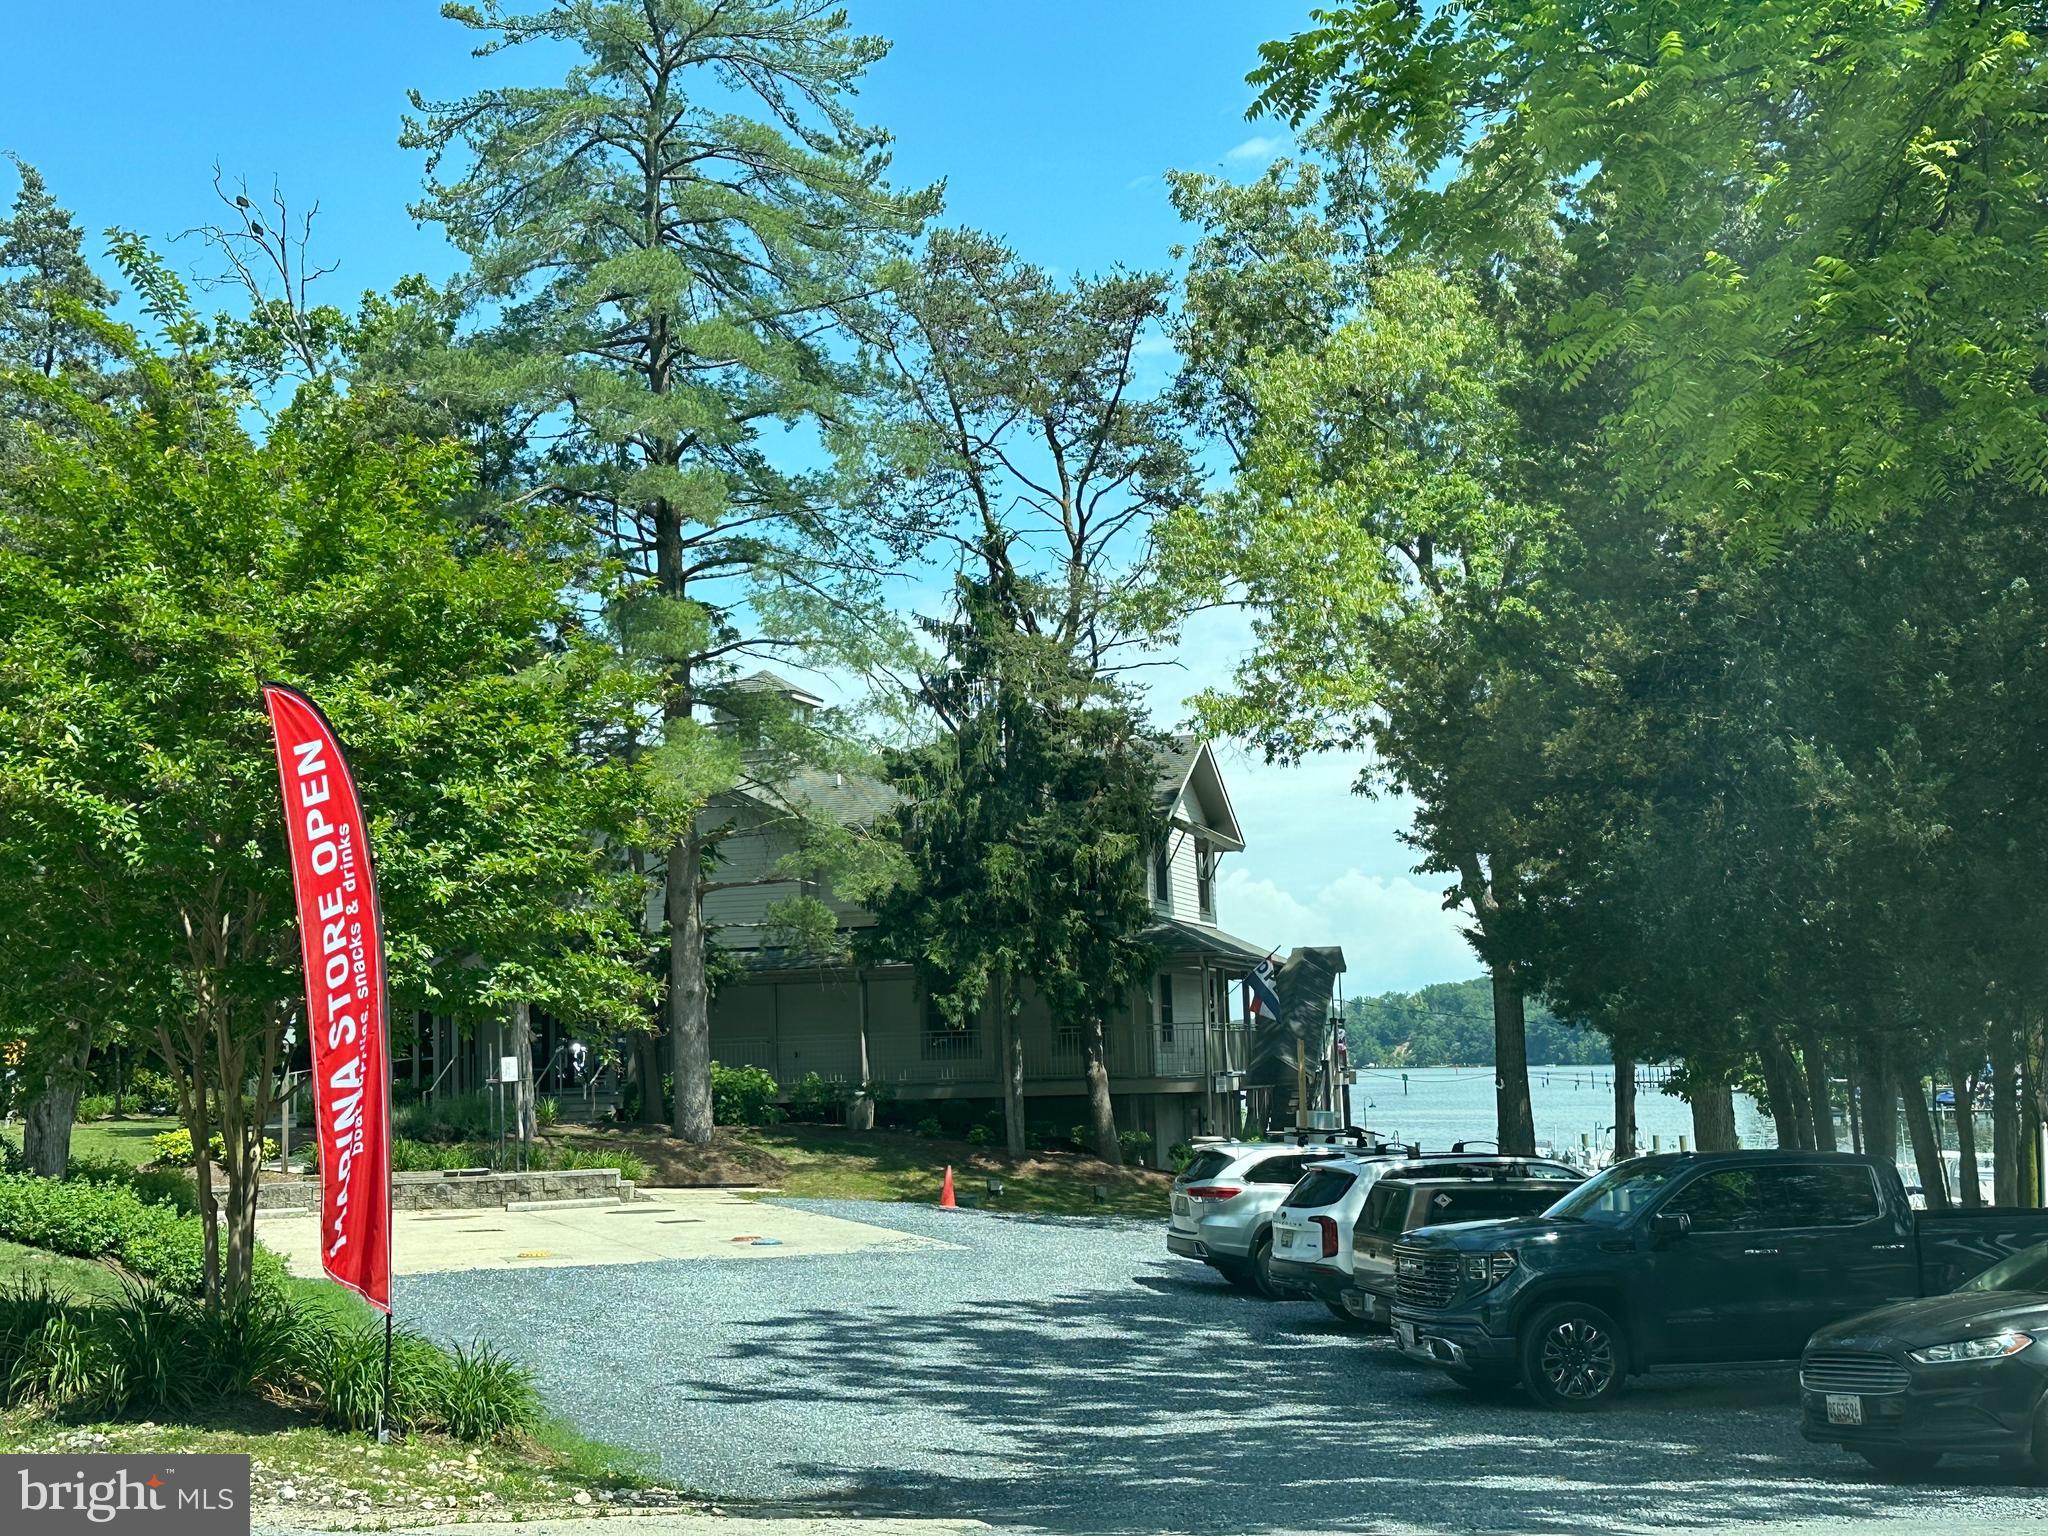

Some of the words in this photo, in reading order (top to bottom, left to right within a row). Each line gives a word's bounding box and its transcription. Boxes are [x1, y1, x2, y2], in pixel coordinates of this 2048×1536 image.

[293, 739, 339, 877] OPEN
[338, 823, 357, 892] drinks
[345, 899, 360, 916] &
[318, 887, 357, 1050] STORE
[349, 922, 369, 1000] snacks
[352, 1105, 364, 1157] boat
